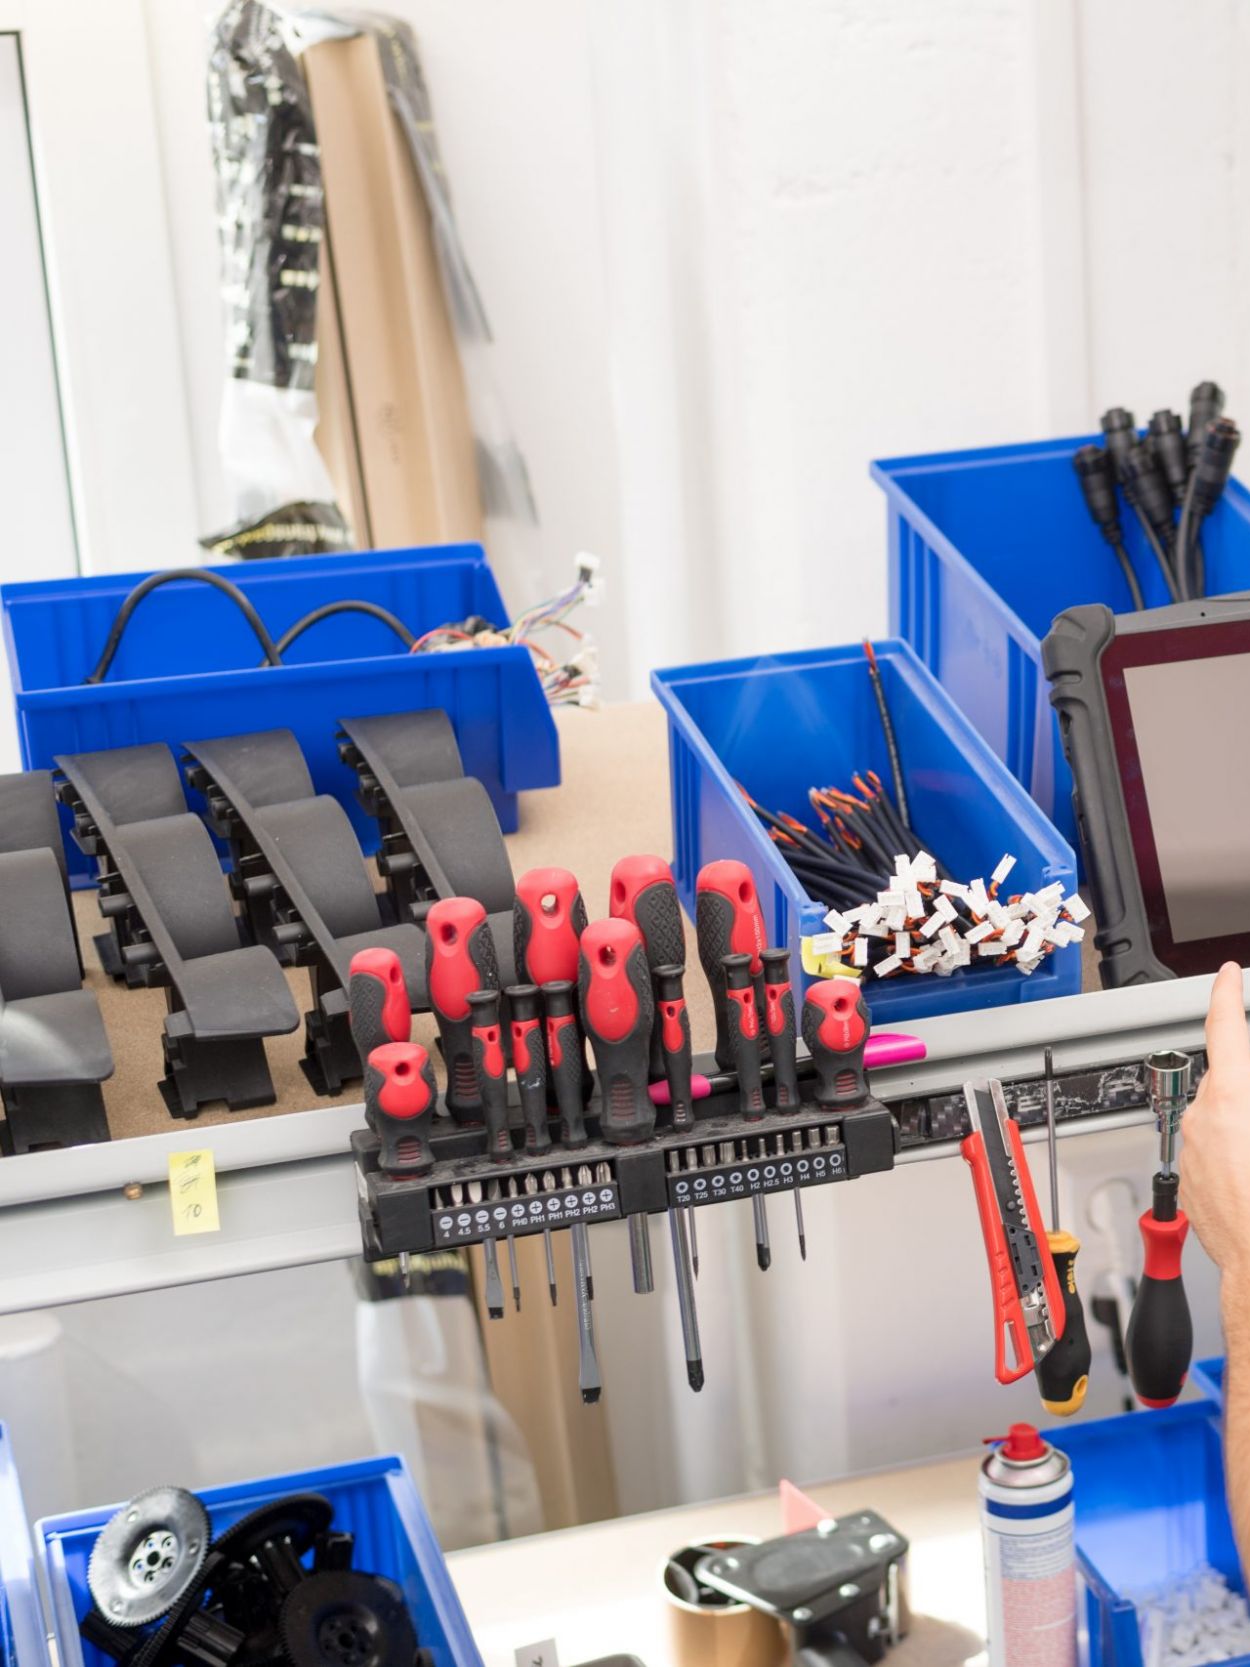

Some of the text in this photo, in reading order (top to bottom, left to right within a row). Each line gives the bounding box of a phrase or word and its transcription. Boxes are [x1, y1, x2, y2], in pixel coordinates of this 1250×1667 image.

[677, 1166, 842, 1203] T20 T25 T30 T40 H2 H2.5 H3 H4 H5 H6
[458, 1227, 471, 1236] 4.5
[477, 1224, 491, 1233] 5.5
[530, 1214, 545, 1224] PH1
[548, 1211, 563, 1220] PH1
[565, 1207, 580, 1217] PH2
[582, 1204, 598, 1214] PH2
[600, 1202, 616, 1211] PH3
